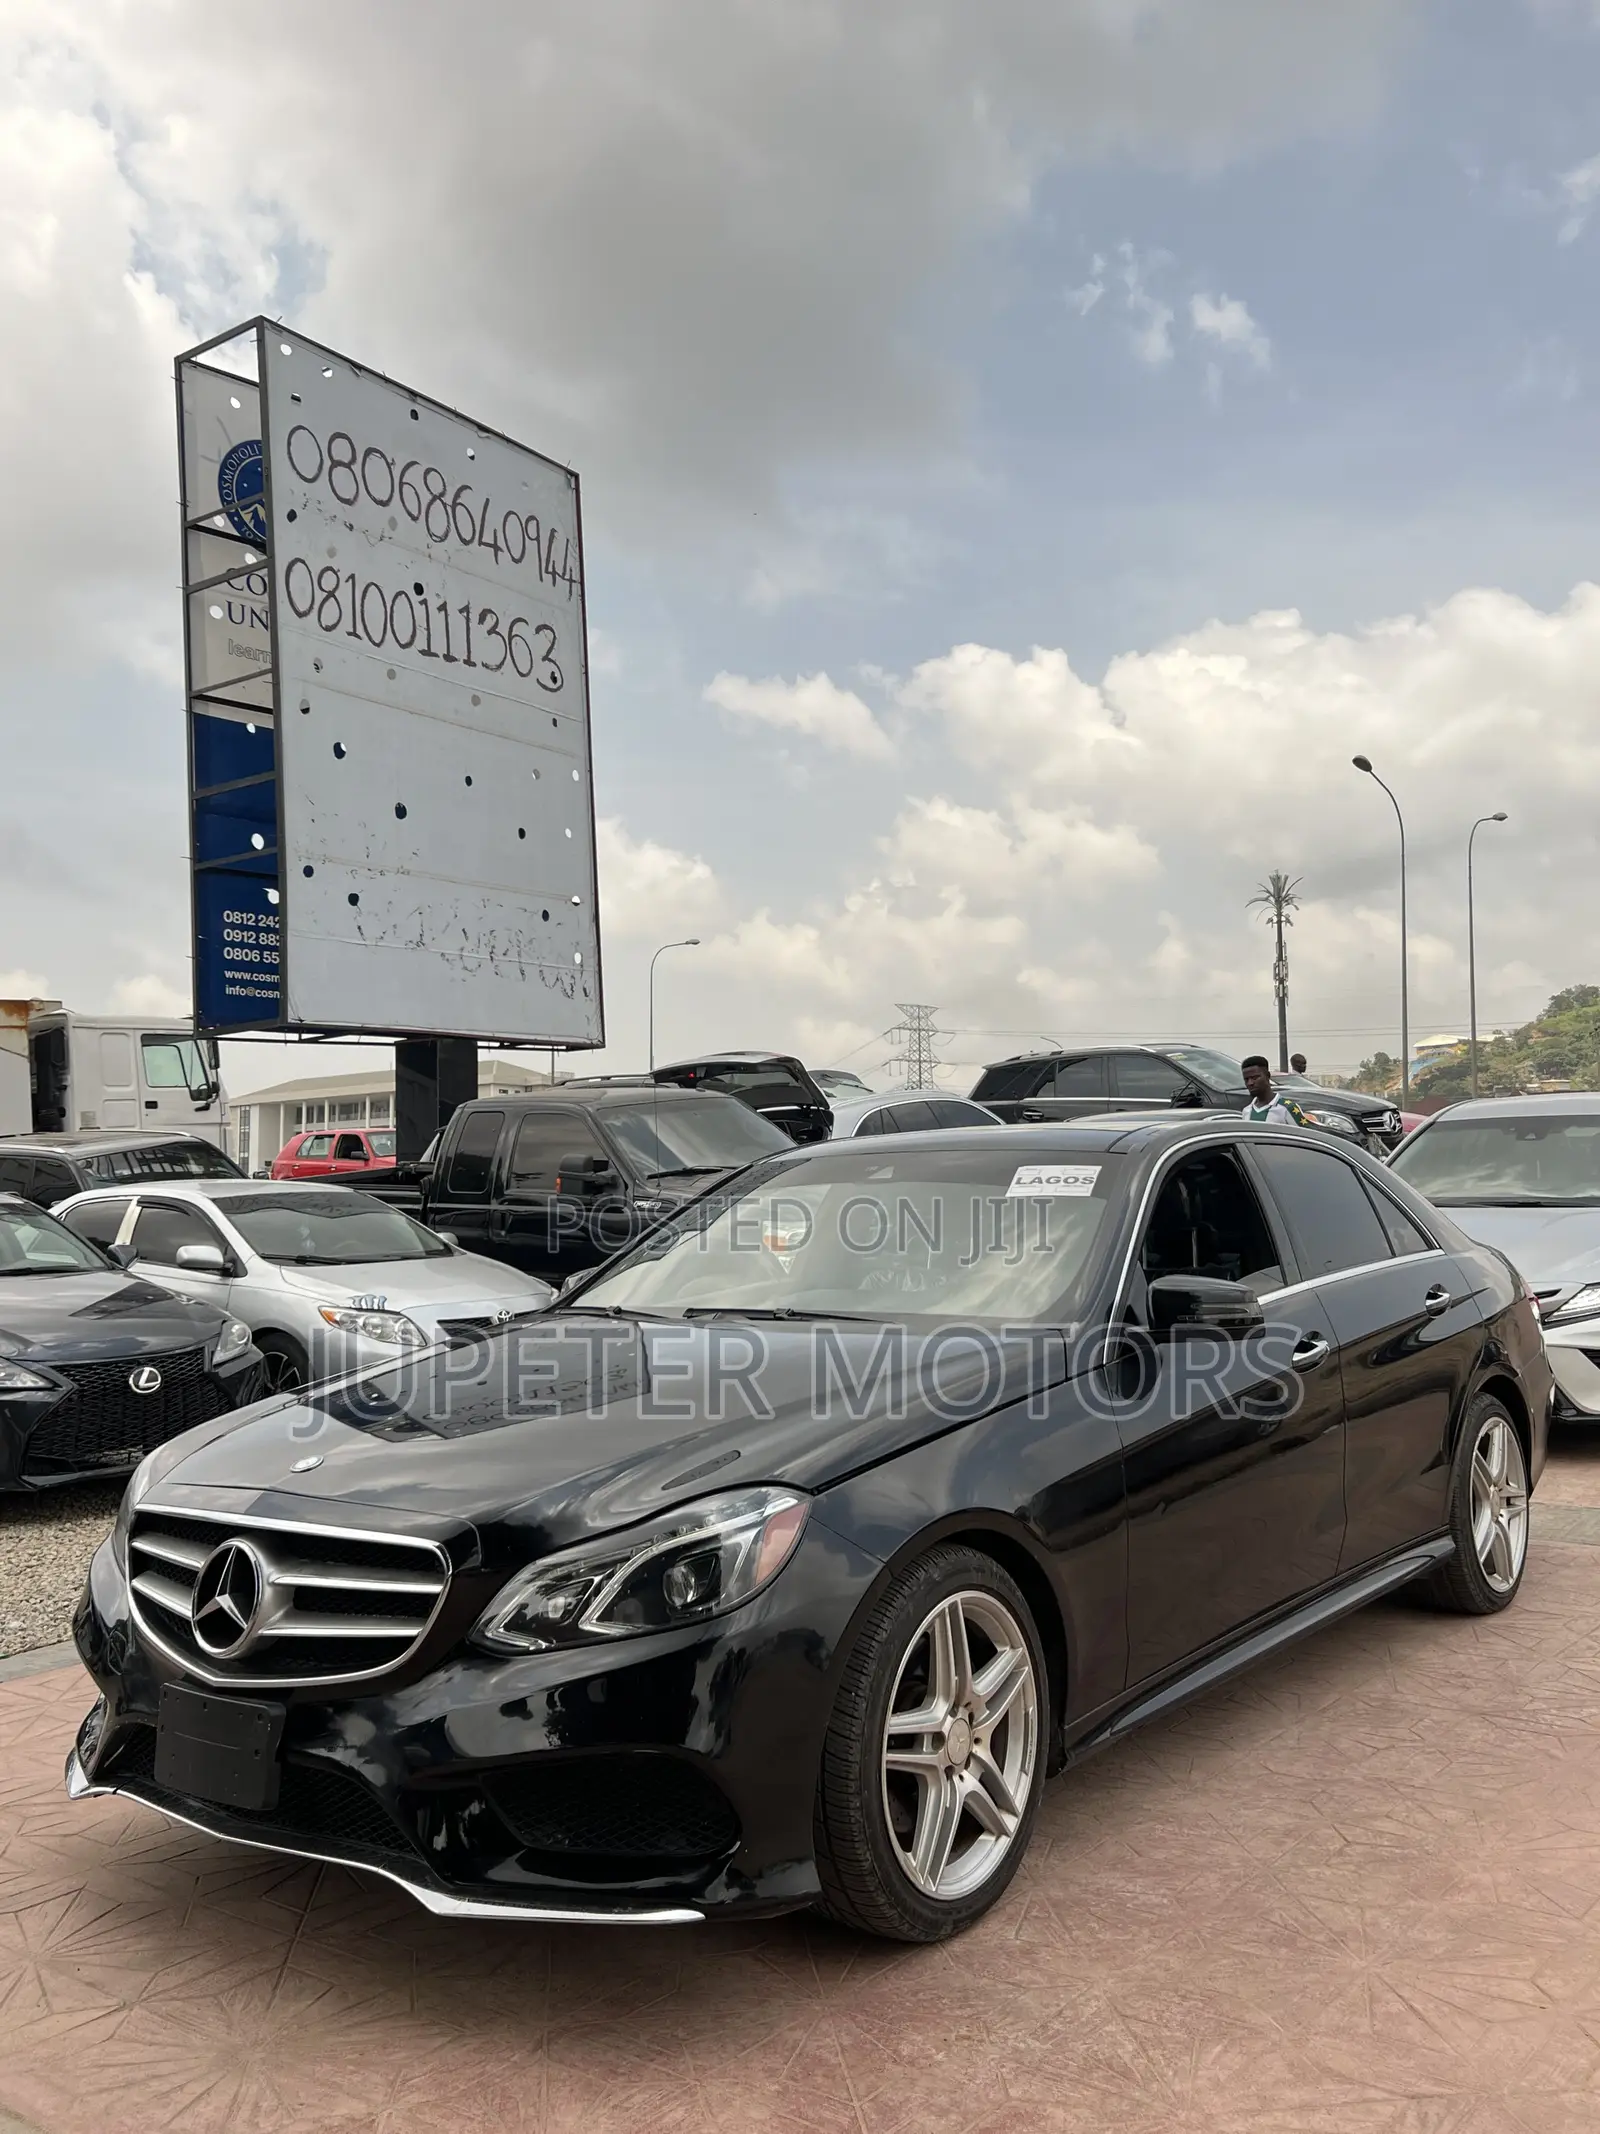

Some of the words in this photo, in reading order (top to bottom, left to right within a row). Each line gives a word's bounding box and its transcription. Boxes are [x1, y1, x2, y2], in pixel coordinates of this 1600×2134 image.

[287, 424, 579, 601] 08068640944
[285, 557, 563, 692] 08100111363
[223, 910, 256, 926] 0812
[223, 929, 256, 944] 0912
[223, 947, 260, 962] 0806
[1014, 1176, 1095, 1185] LAGOS
